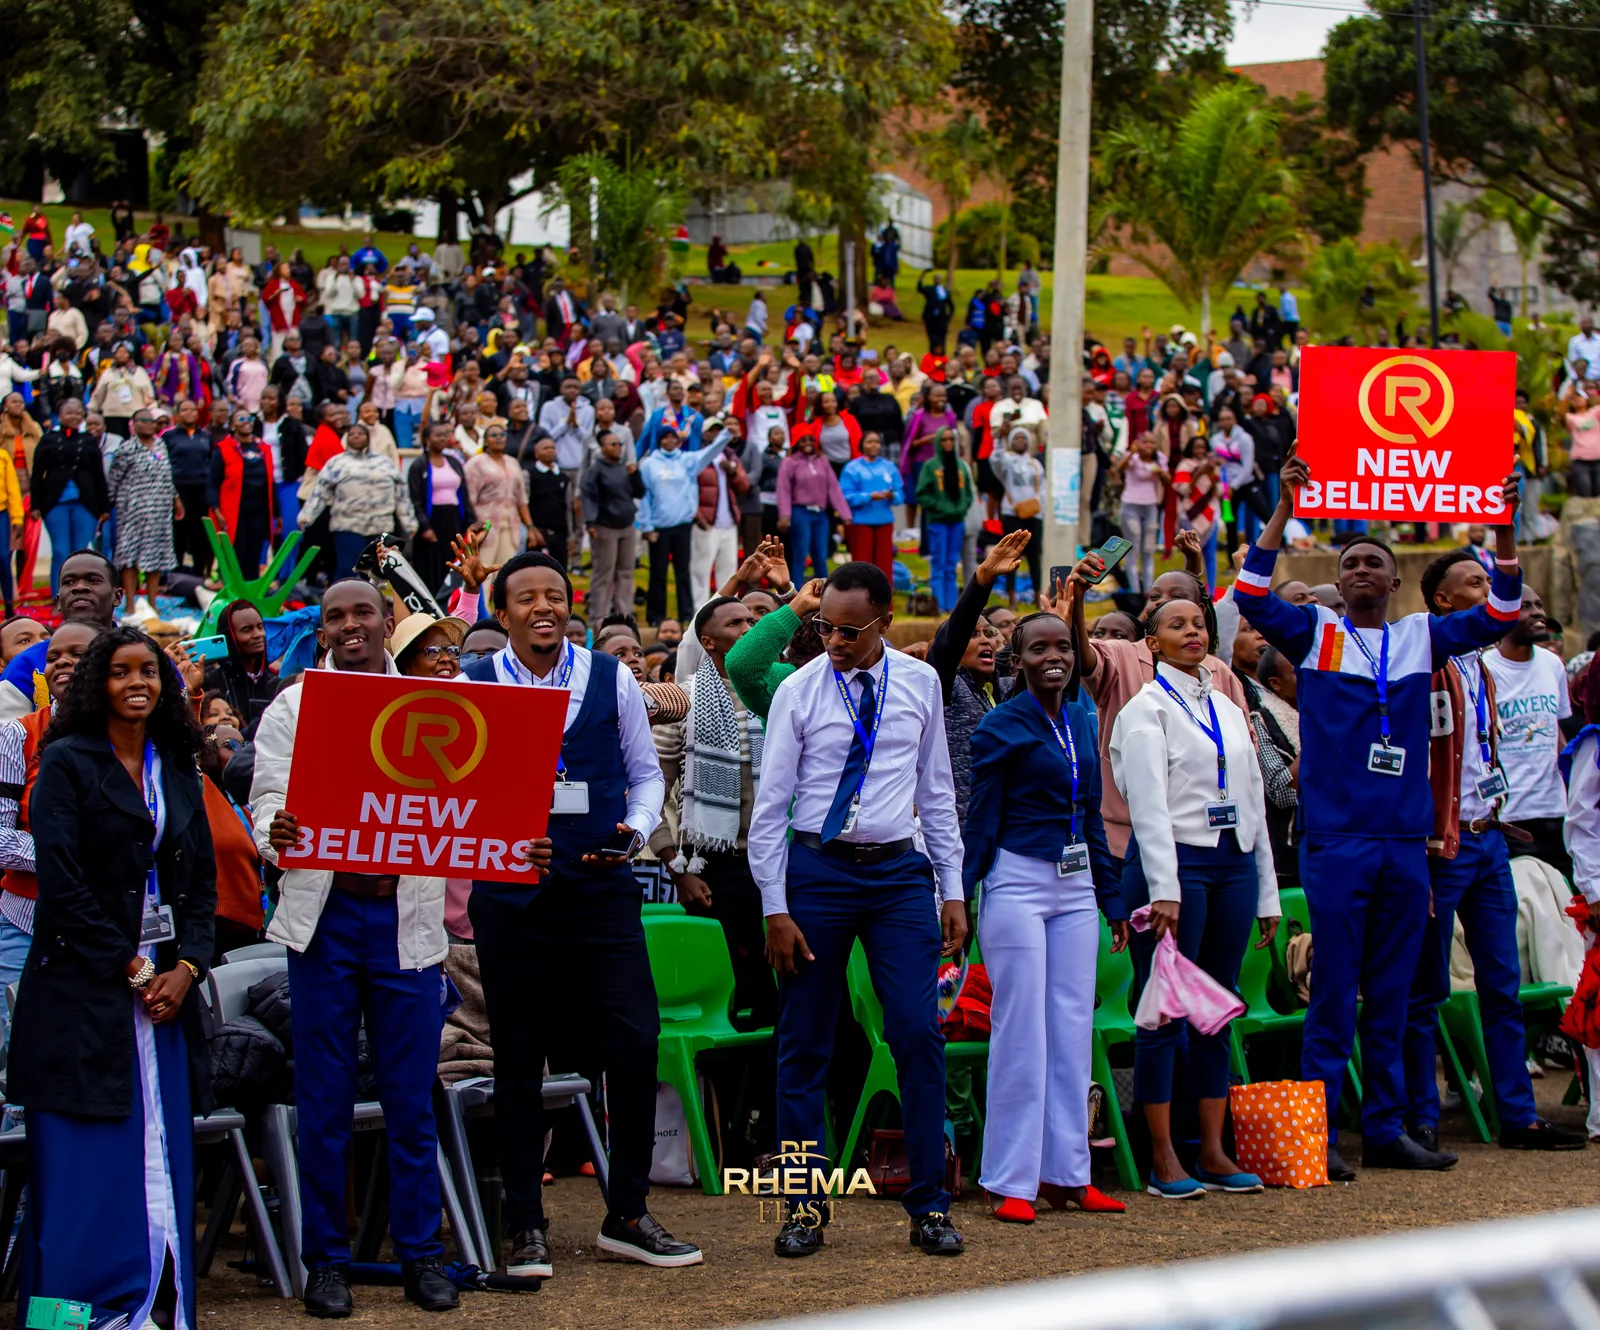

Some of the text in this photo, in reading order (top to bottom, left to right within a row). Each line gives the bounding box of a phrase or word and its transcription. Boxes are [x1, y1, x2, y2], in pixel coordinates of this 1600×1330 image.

[1356, 447, 1452, 479] NEW
[1299, 479, 1506, 516] BELIEVERS
[1497, 694, 1558, 719] MAYERS
[359, 791, 478, 830] NEW
[285, 825, 534, 873] BELIEVERS
